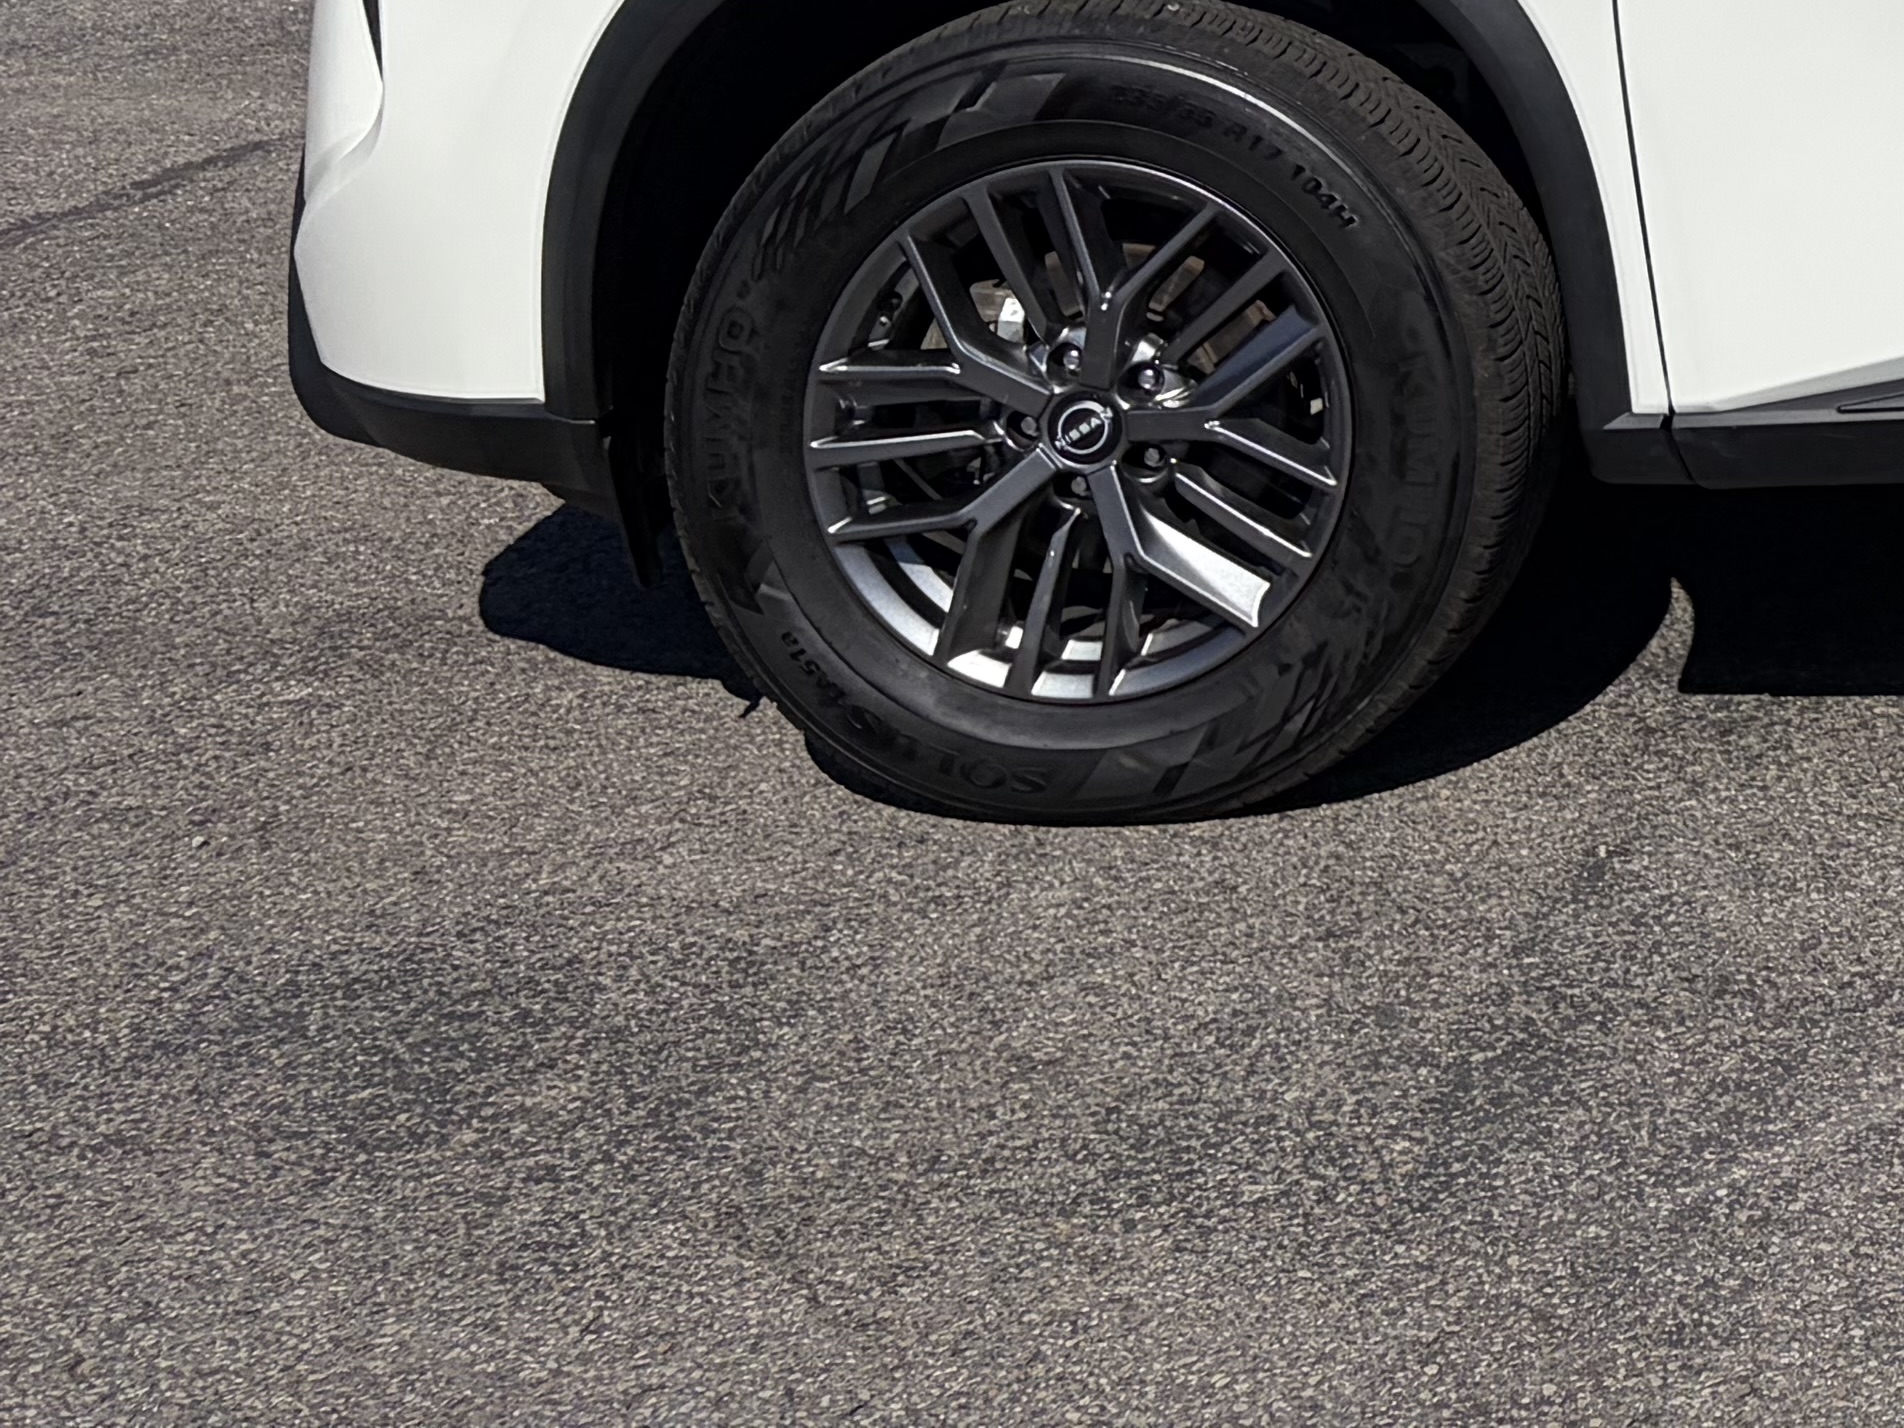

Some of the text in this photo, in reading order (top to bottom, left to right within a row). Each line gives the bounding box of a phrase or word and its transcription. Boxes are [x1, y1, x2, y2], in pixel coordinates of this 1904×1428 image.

[1289, 163, 1359, 231] 104H
[703, 305, 756, 521] KUMHO
[1053, 405, 1114, 451] NISSAN
